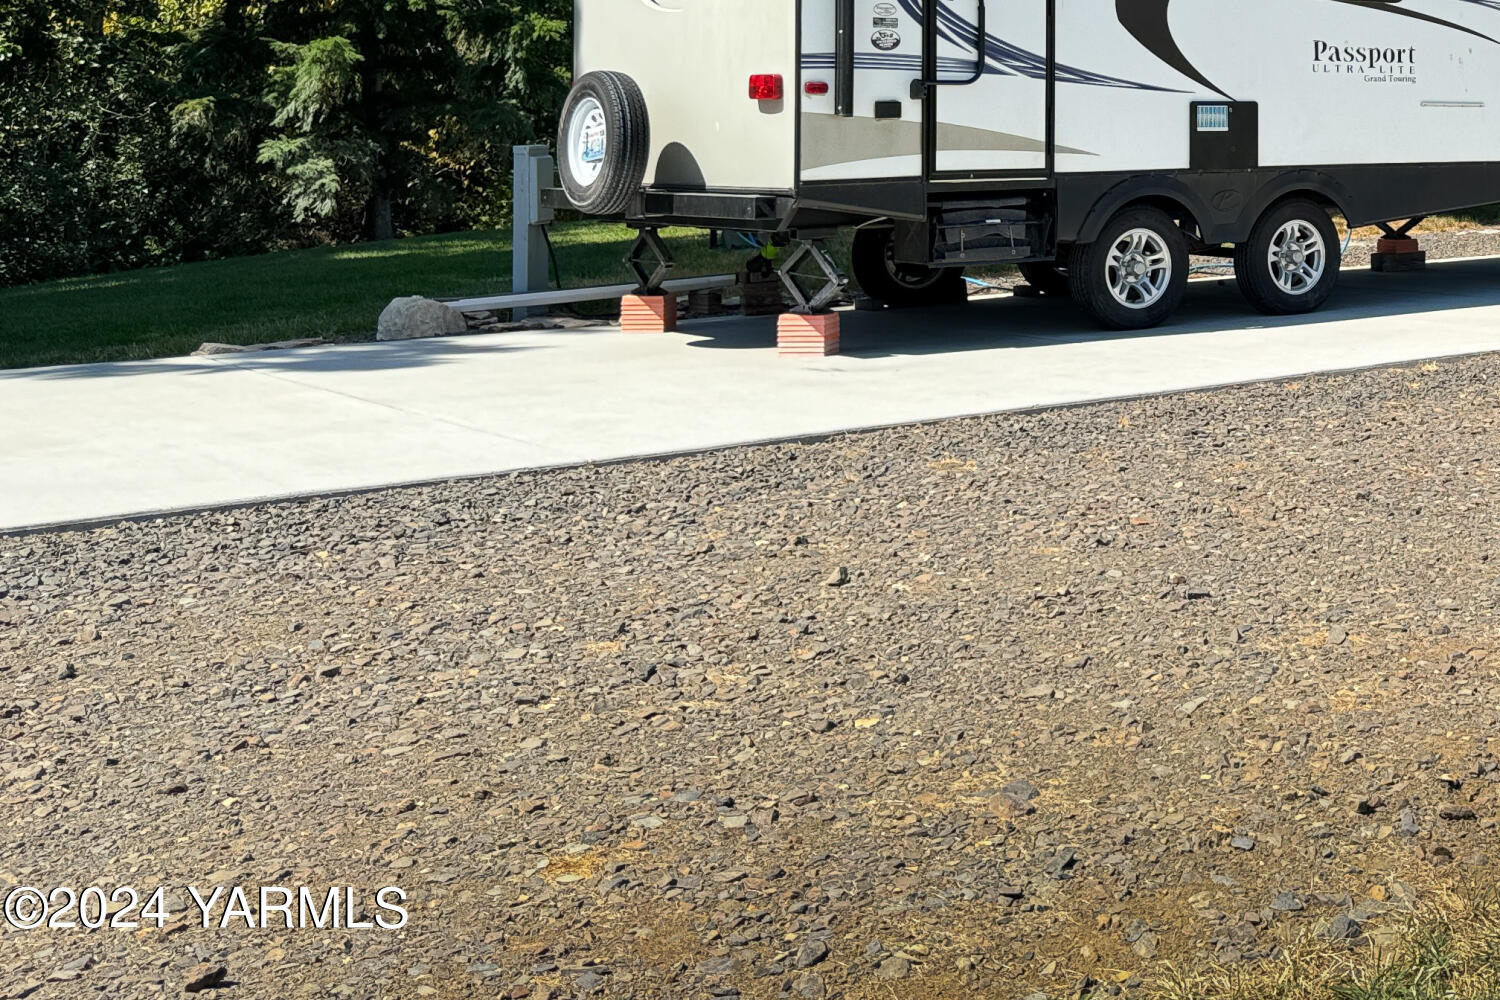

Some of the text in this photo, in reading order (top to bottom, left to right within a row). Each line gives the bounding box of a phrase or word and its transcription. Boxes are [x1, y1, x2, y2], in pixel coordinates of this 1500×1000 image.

[1313, 39, 1416, 69] Passport
[1312, 63, 1416, 75] ULTRA LITE
[1363, 74, 1416, 84] Grand Touring
